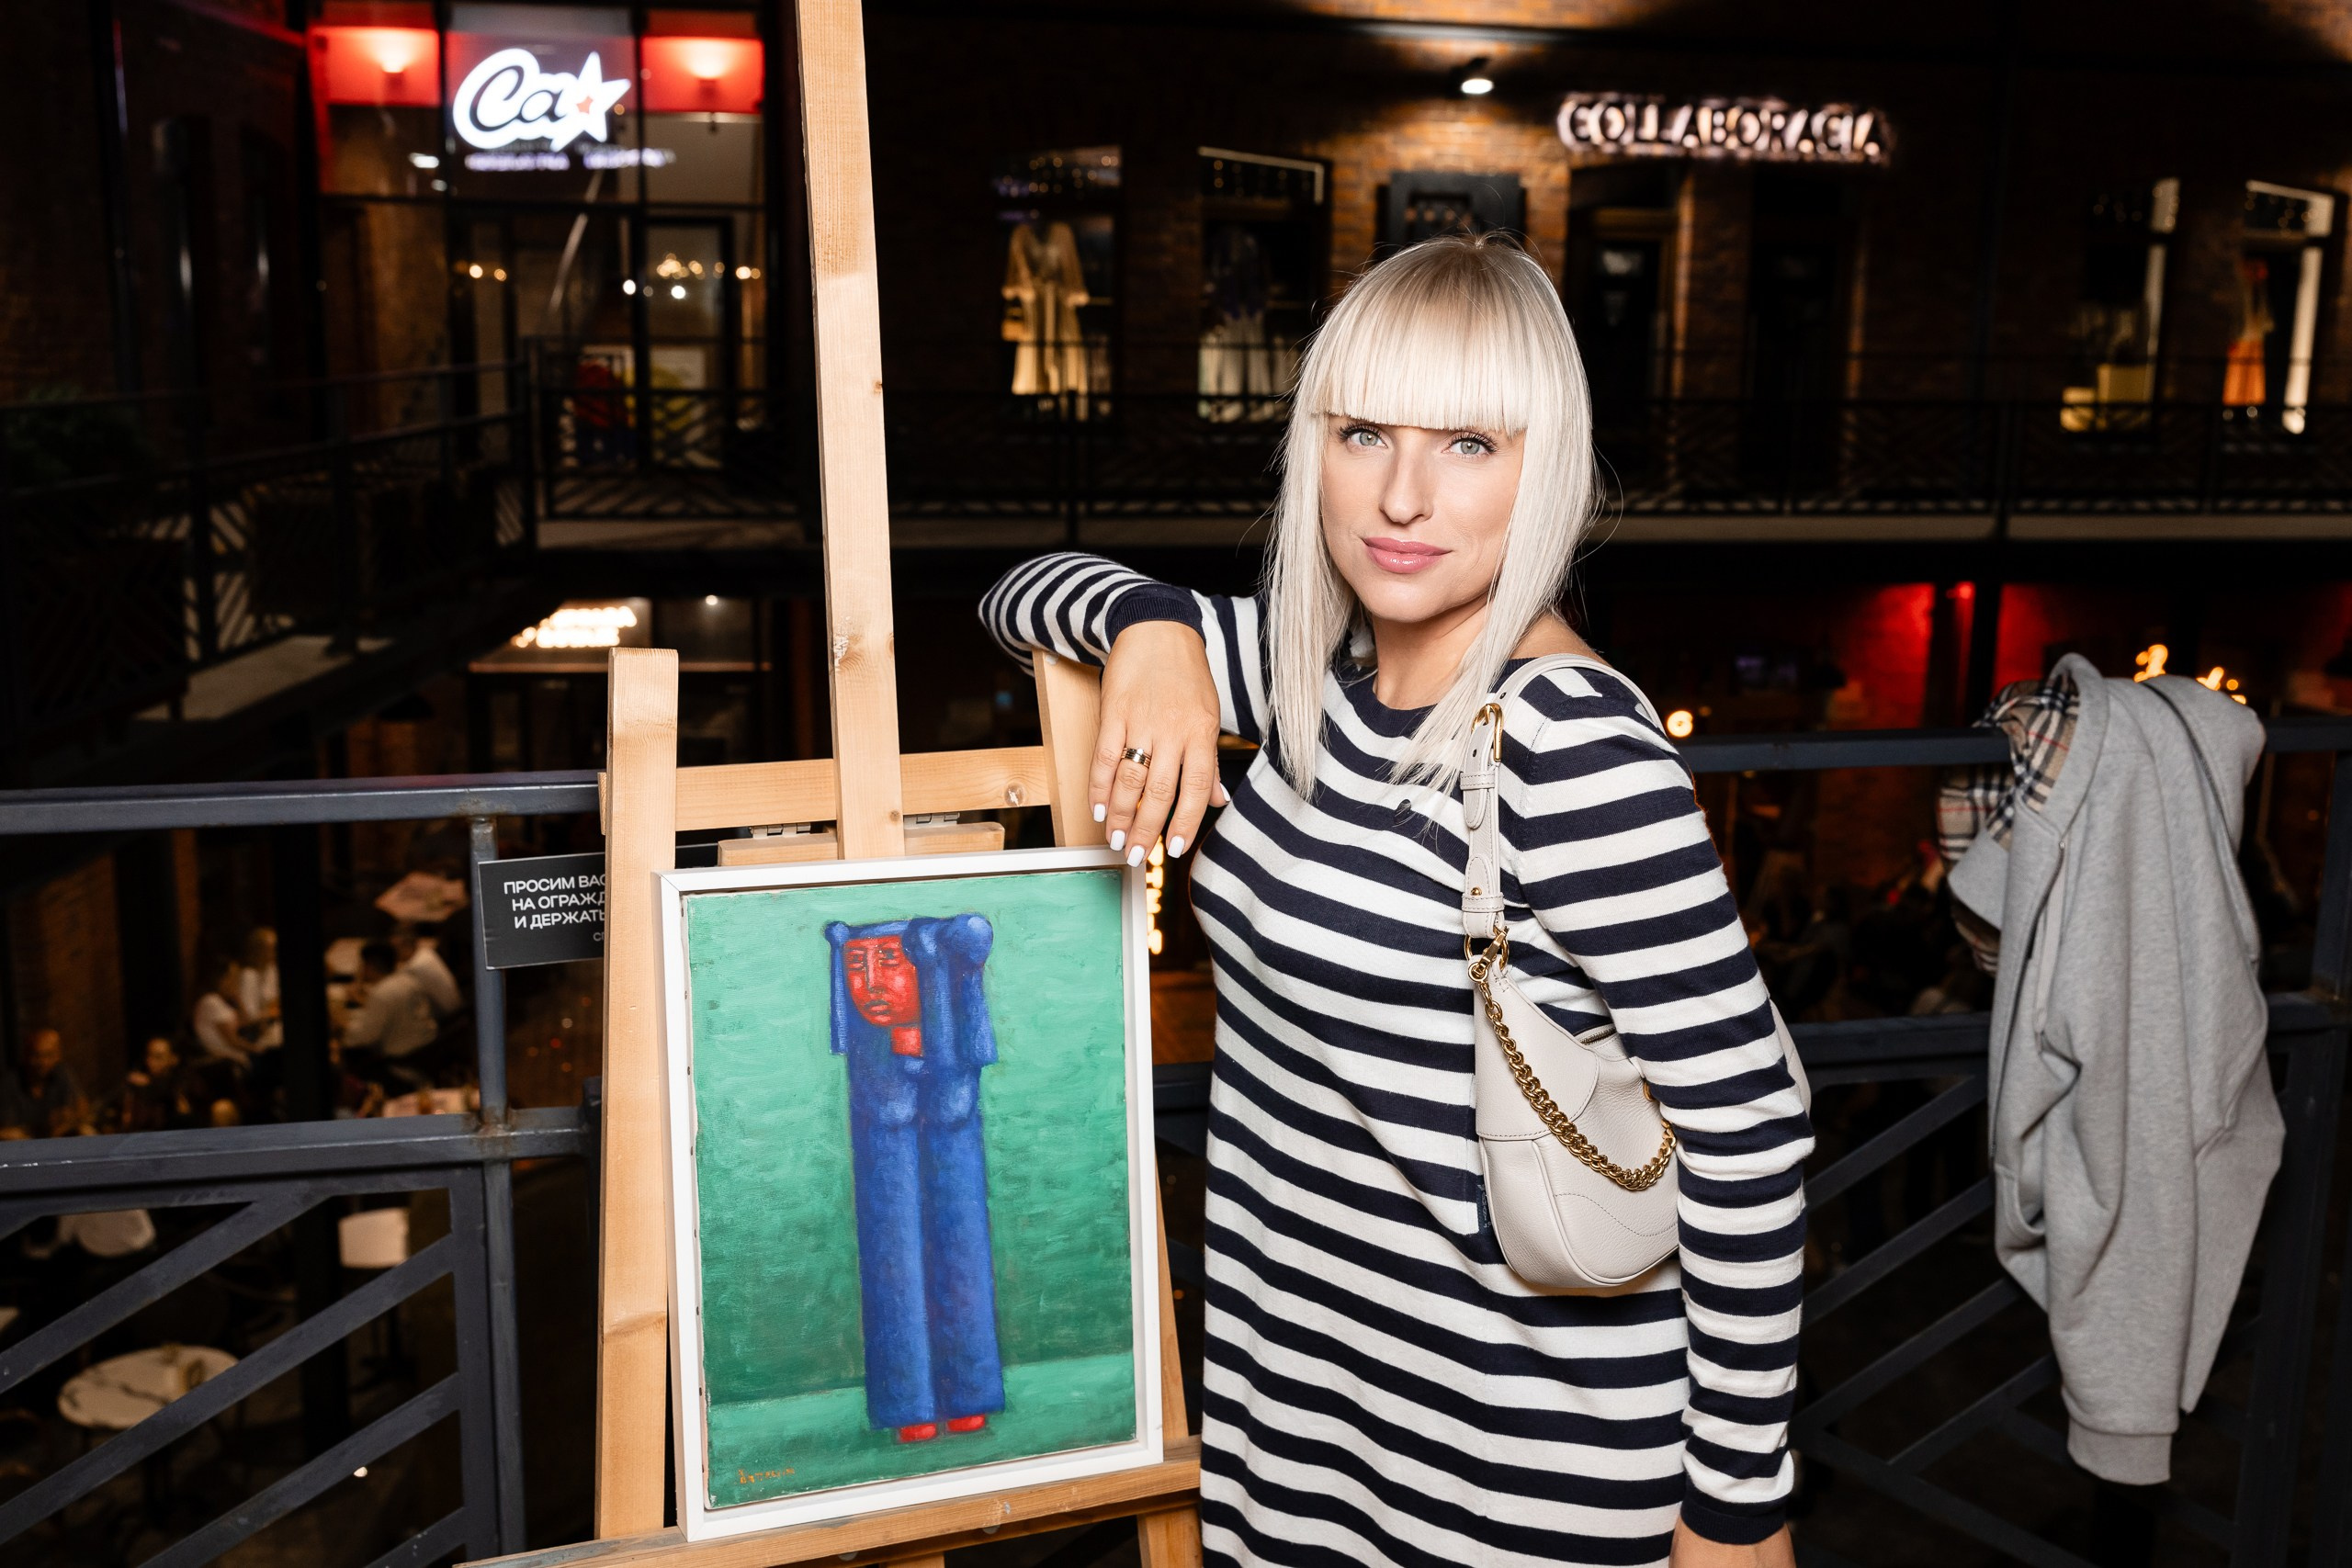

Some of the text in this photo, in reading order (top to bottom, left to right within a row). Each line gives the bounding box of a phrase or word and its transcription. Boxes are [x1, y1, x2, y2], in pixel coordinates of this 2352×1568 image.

[503, 876, 575, 894] ПРОСИМ
[512, 897, 536, 911] НА
[514, 916, 527, 929] И
